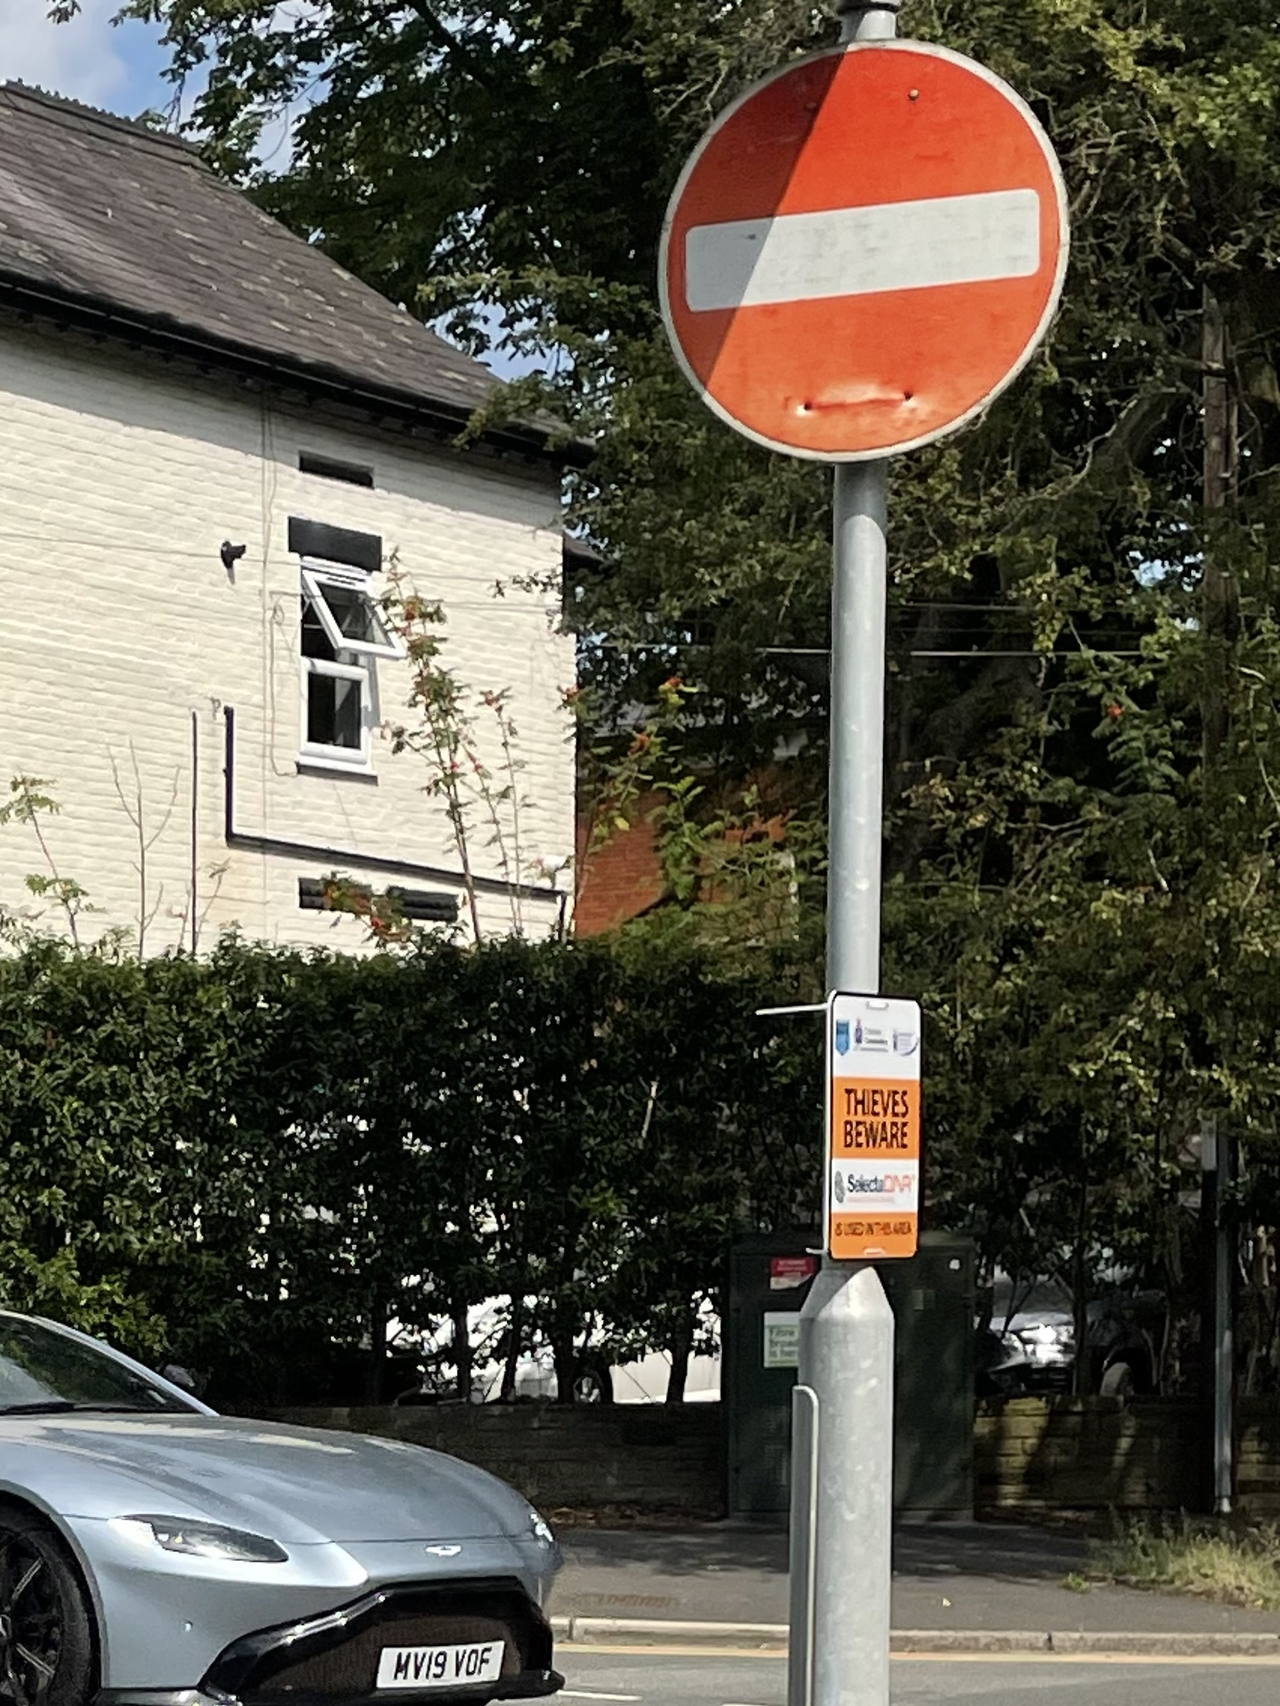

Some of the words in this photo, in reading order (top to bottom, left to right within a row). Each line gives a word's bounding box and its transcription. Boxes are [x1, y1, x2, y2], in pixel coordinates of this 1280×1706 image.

[844, 1088, 909, 1118] THIEVES
[843, 1120, 909, 1149] BEWARE
[393, 1650, 448, 1680] MV19
[455, 1646, 493, 1678] VOF
